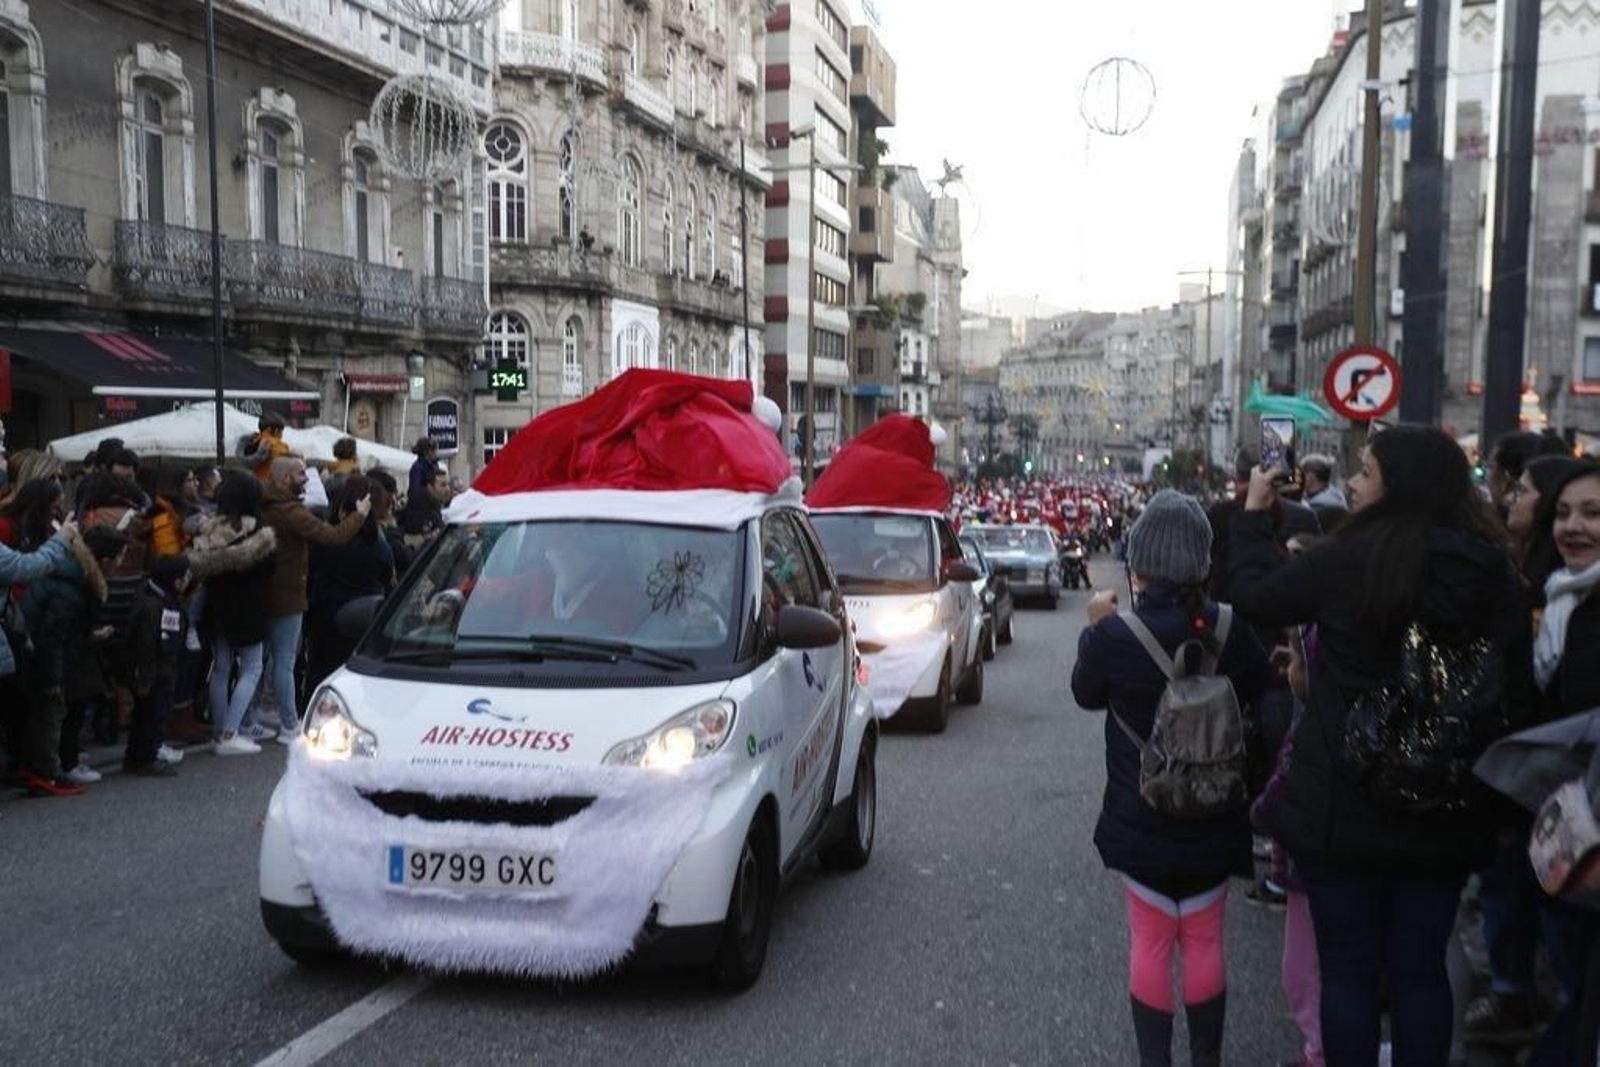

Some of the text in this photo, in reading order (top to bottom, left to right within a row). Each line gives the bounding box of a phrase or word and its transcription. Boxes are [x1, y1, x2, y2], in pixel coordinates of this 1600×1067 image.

[421, 725, 574, 752] AIR-HOSTESS
[410, 852, 555, 885] 9799 GXC
